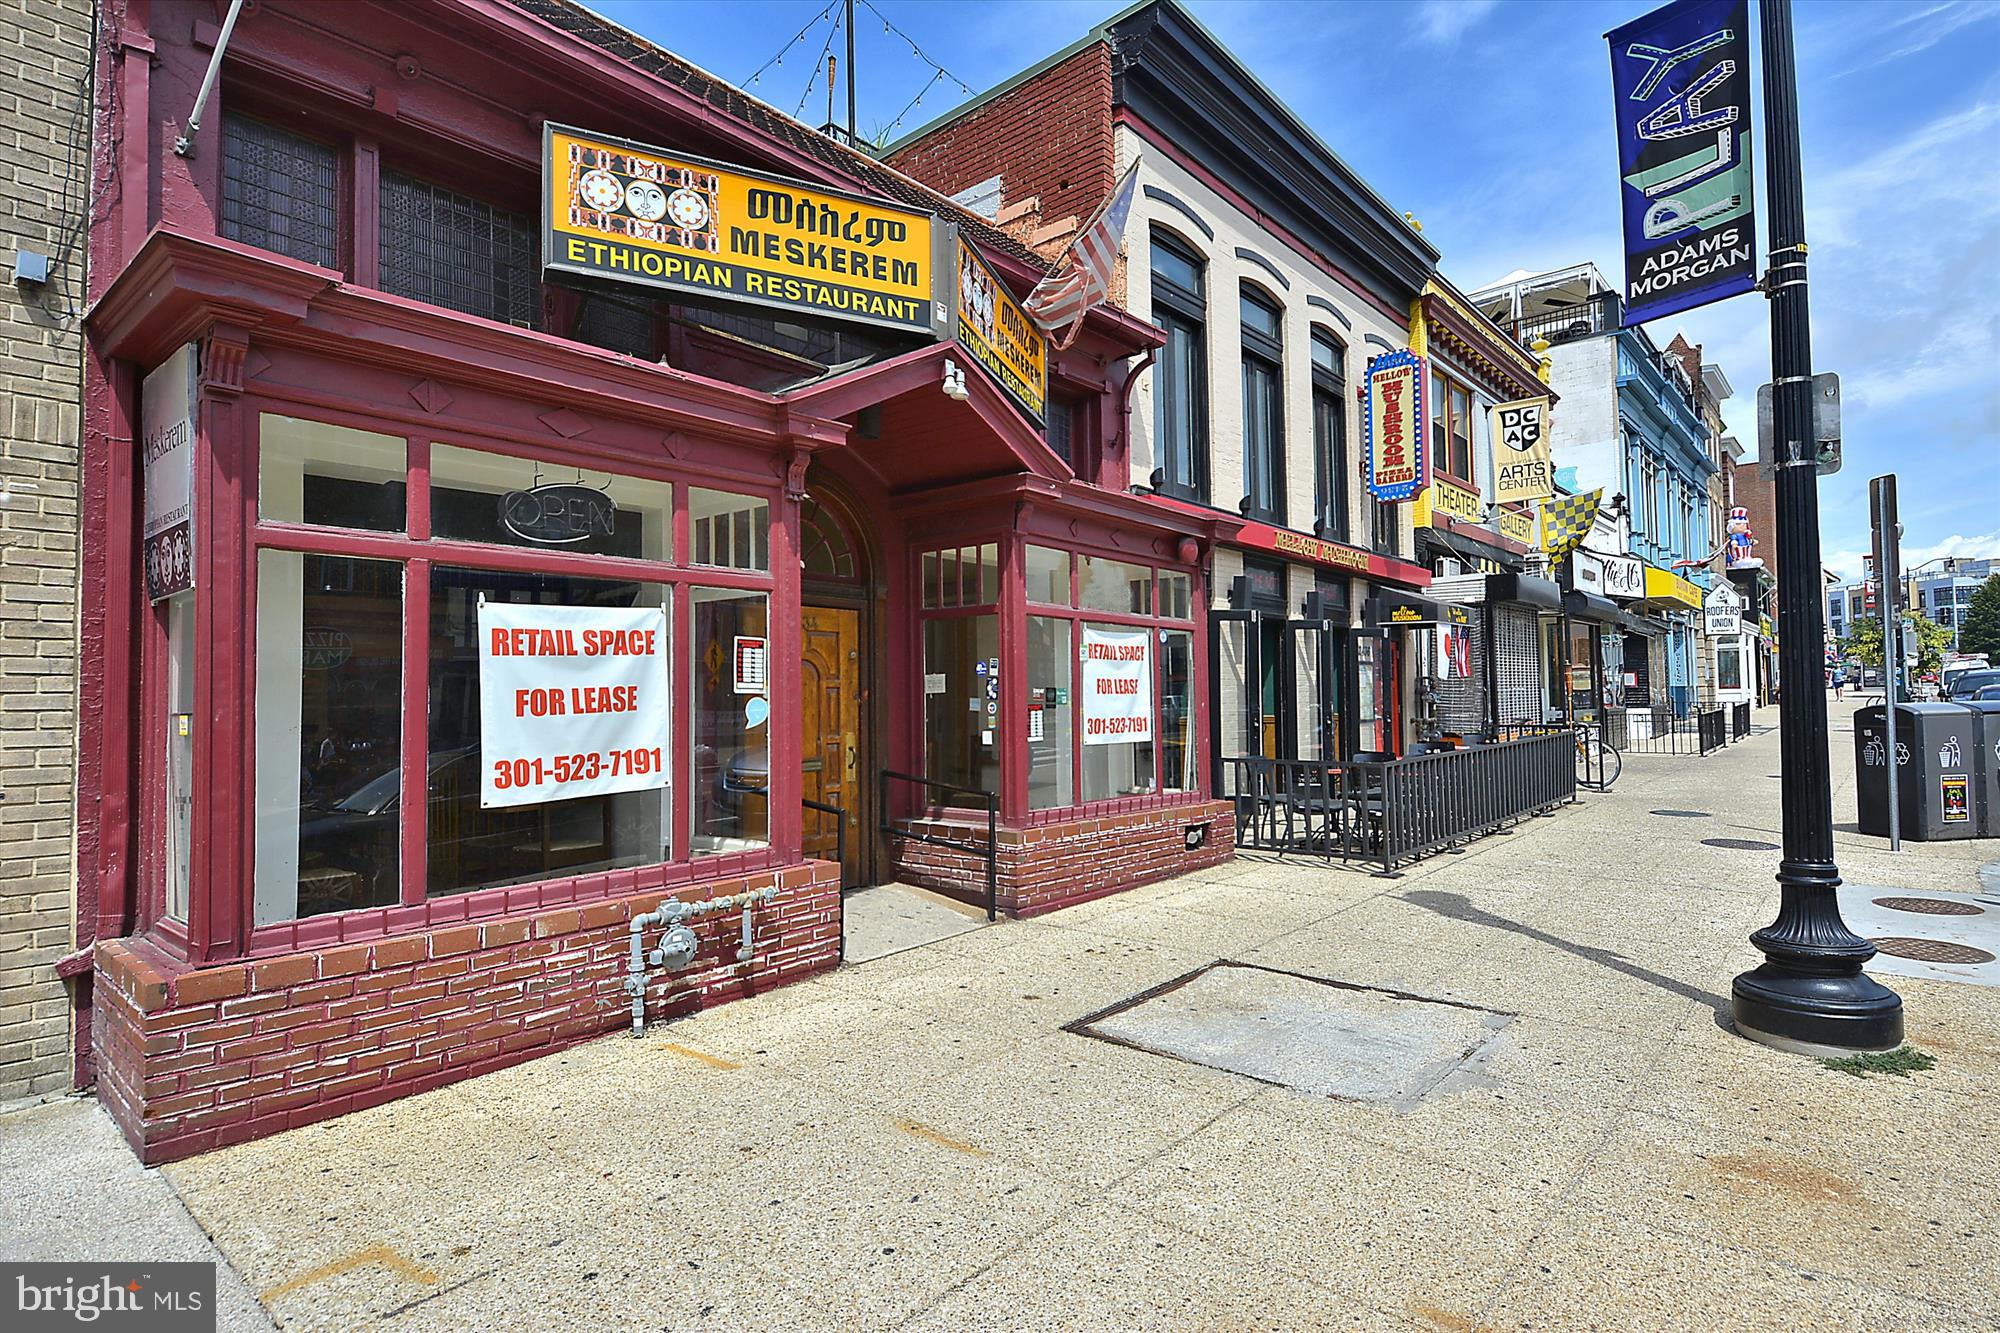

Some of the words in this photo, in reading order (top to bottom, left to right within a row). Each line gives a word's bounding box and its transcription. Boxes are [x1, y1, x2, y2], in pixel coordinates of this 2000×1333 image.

[1626, 29, 1741, 240] PLAY
[730, 226, 918, 287] MESKEREM
[1640, 228, 1739, 276] ADAMS
[567, 237, 733, 289] ETHIOPIAN
[746, 272, 920, 321] RESTAURANT
[1630, 244, 1751, 299] MORGAN
[959, 321, 1001, 377] ETHIOPIAN
[1001, 365, 1044, 417] RESTAURANT
[997, 328, 1042, 389] MESKEREM
[1372, 367, 1412, 383] MELLOW
[1381, 379, 1406, 469] MUSHROOM
[145, 420, 187, 468] Meskerem
[1375, 466, 1413, 478] PIZZA
[1376, 473, 1414, 485] BAKERS
[1499, 475, 1546, 491] CENTER
[1500, 461, 1546, 480] ARTS
[504, 490, 616, 536] OPEN
[1436, 483, 1478, 518] THEATER
[1501, 511, 1532, 539] GALLERY
[1706, 605, 1740, 616] ROOFERS
[1711, 617, 1734, 628] UNION
[491, 628, 578, 657] RETAIL
[583, 629, 656, 656] SPACE
[1088, 645, 1118, 661] RETAIL
[1119, 647, 1145, 661] SPACE
[515, 688, 565, 717] FOR
[572, 686, 638, 715] LEASE
[1096, 678, 1113, 695] FOR
[1114, 678, 1138, 695] LEASE
[1087, 717, 1147, 735] 301-523-7191
[494, 747, 662, 790] 301-523-7191
